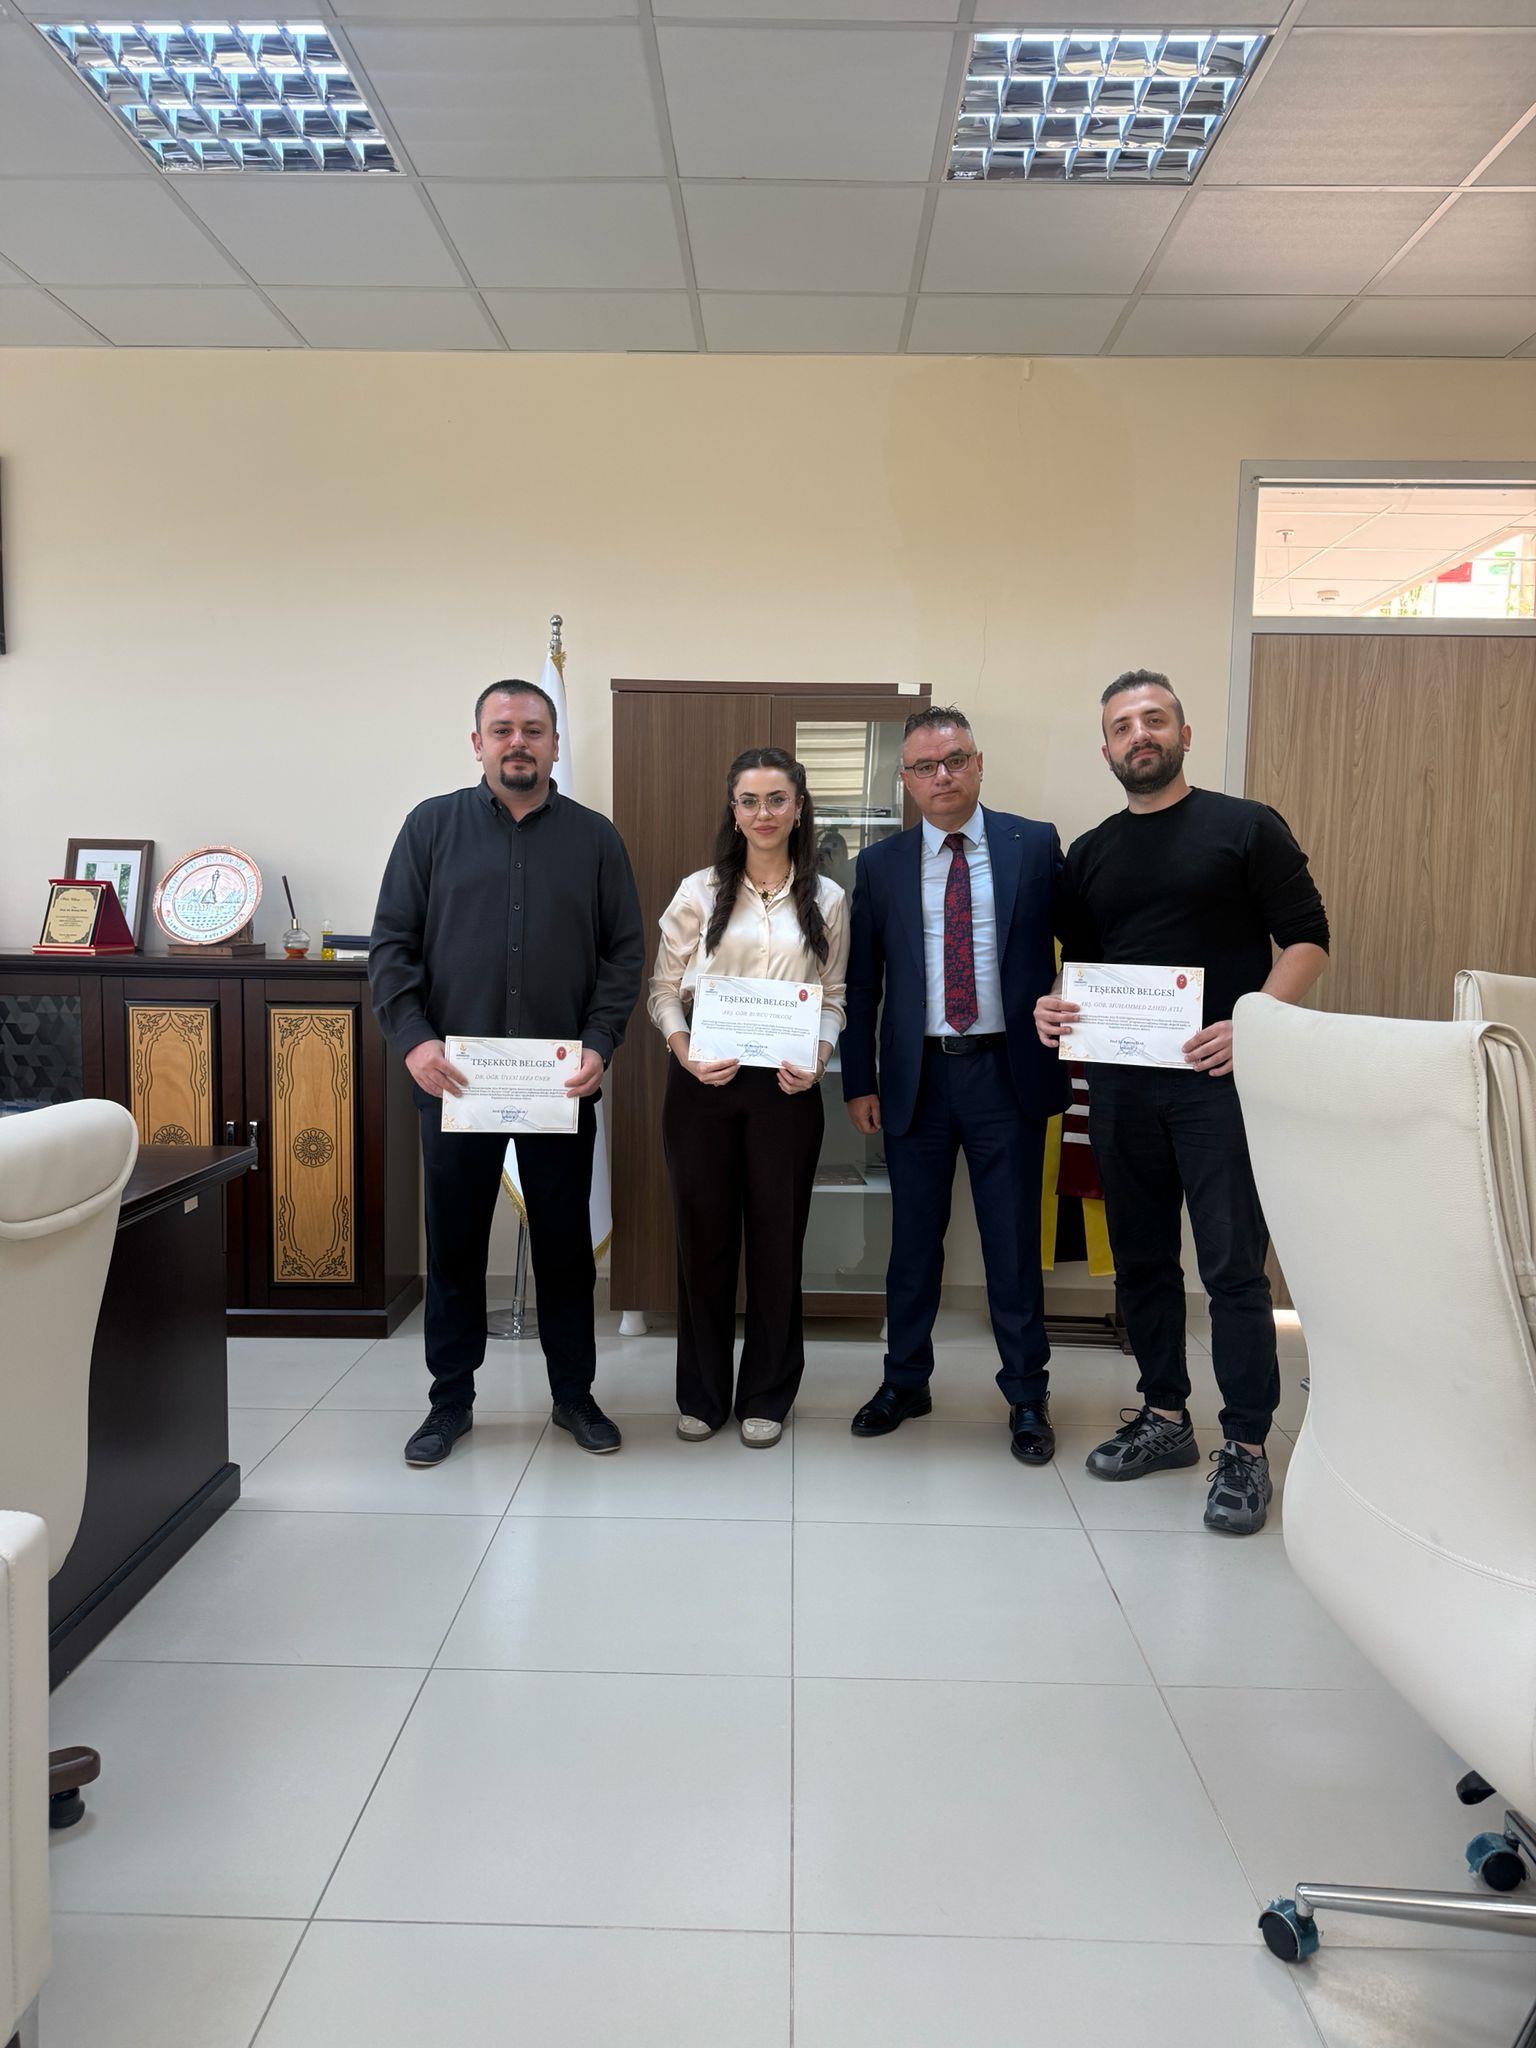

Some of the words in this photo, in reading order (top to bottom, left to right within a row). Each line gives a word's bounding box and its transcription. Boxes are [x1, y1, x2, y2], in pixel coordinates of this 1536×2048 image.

[1088, 985, 1136, 995] TEŞEKKÜR
[1137, 987, 1175, 997] BELGESİ
[719, 995, 762, 1005] TEŞEKKÜR
[763, 998, 798, 1008] BELGESİ
[471, 1058, 518, 1068] TEŞEKKÜR
[519, 1060, 556, 1068] BELGESİ
